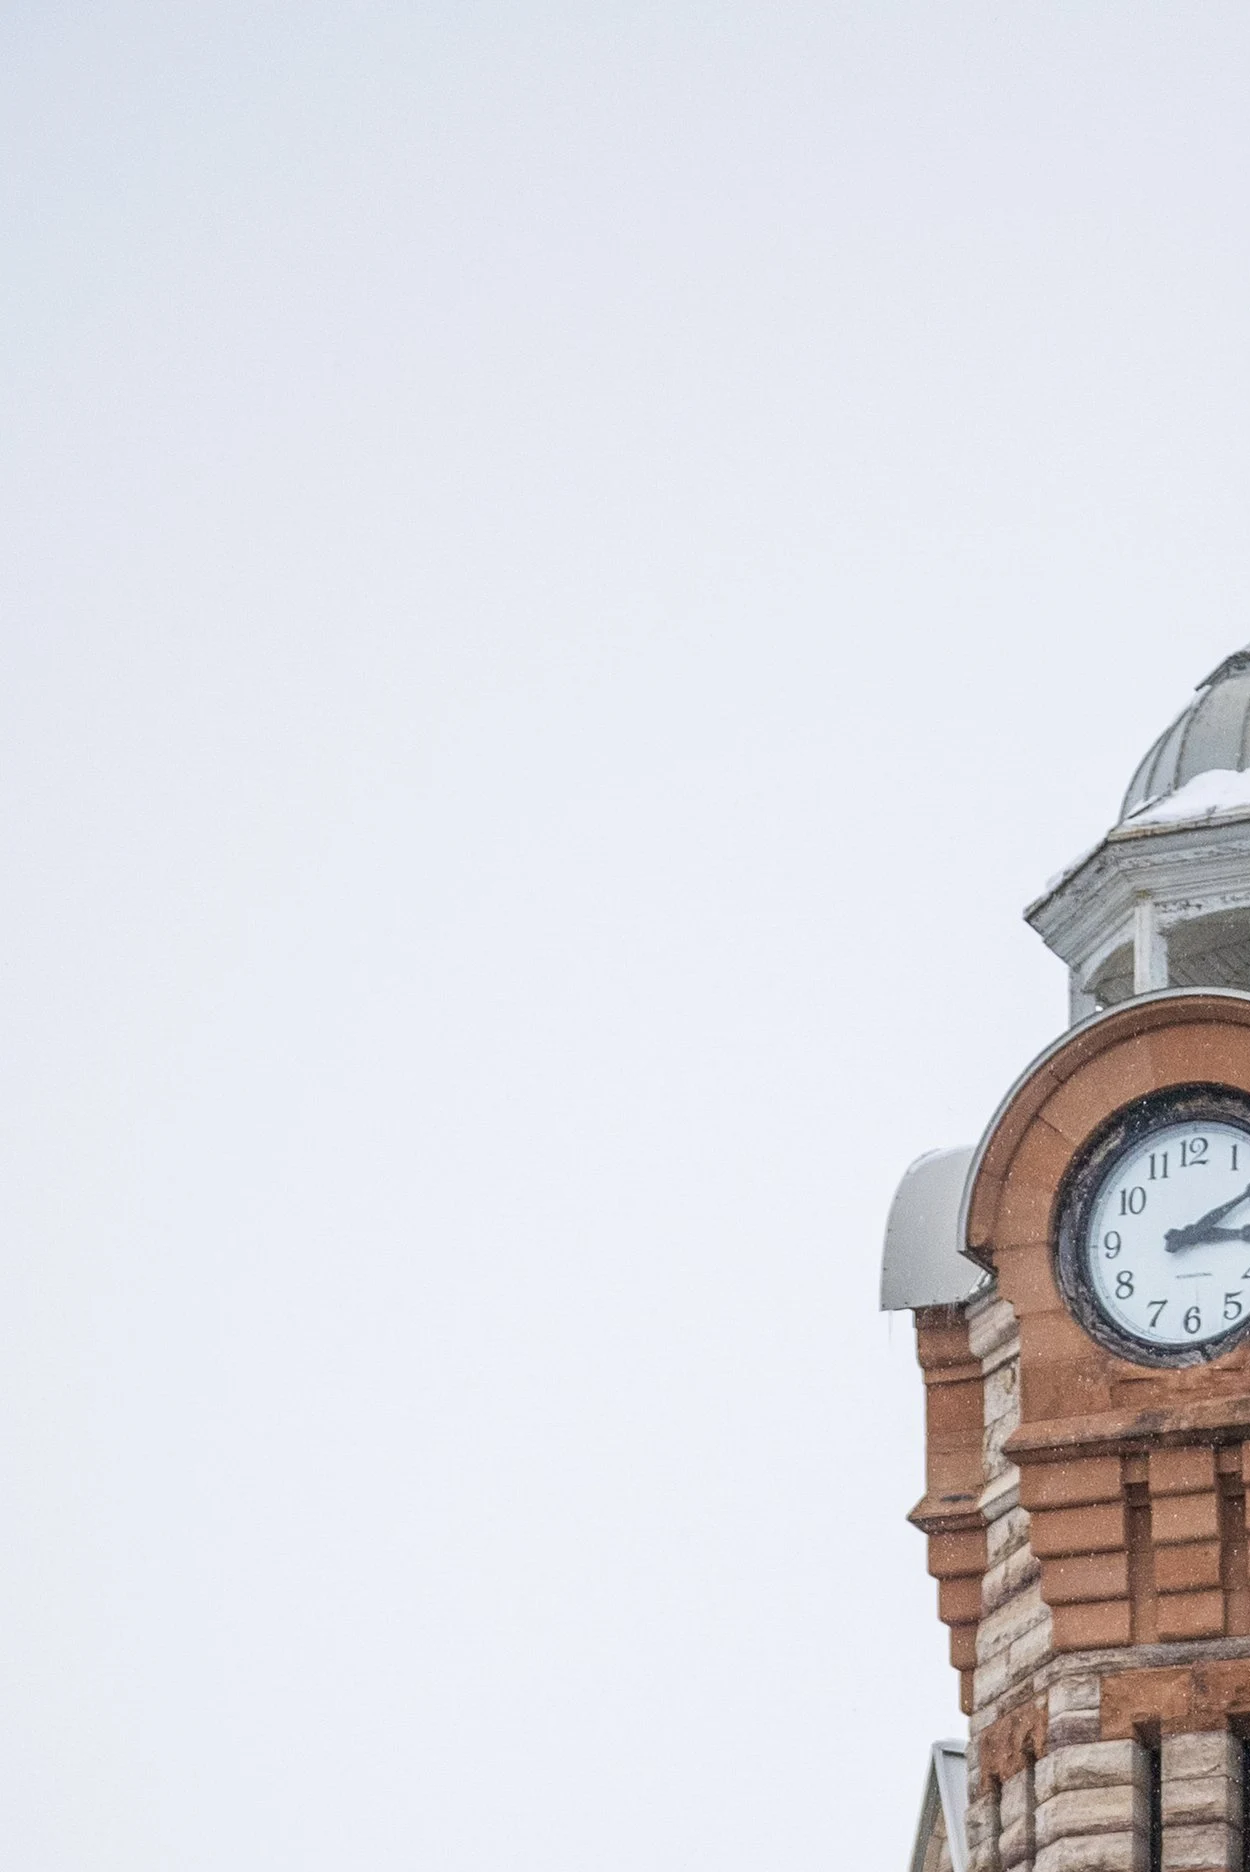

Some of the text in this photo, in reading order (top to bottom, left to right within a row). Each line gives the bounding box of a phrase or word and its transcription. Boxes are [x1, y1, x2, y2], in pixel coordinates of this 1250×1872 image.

[1147, 1151, 1170, 1181] 11
[1179, 1137, 1210, 1168] 12
[1230, 1143, 1239, 1171] 1
[1118, 1186, 1147, 1216] 10
[1103, 1230, 1122, 1260] 9
[1115, 1270, 1135, 1300] 8
[1147, 1299, 1169, 1328] 7
[1183, 1305, 1201, 1335] 6
[1223, 1290, 1243, 1321] 5
